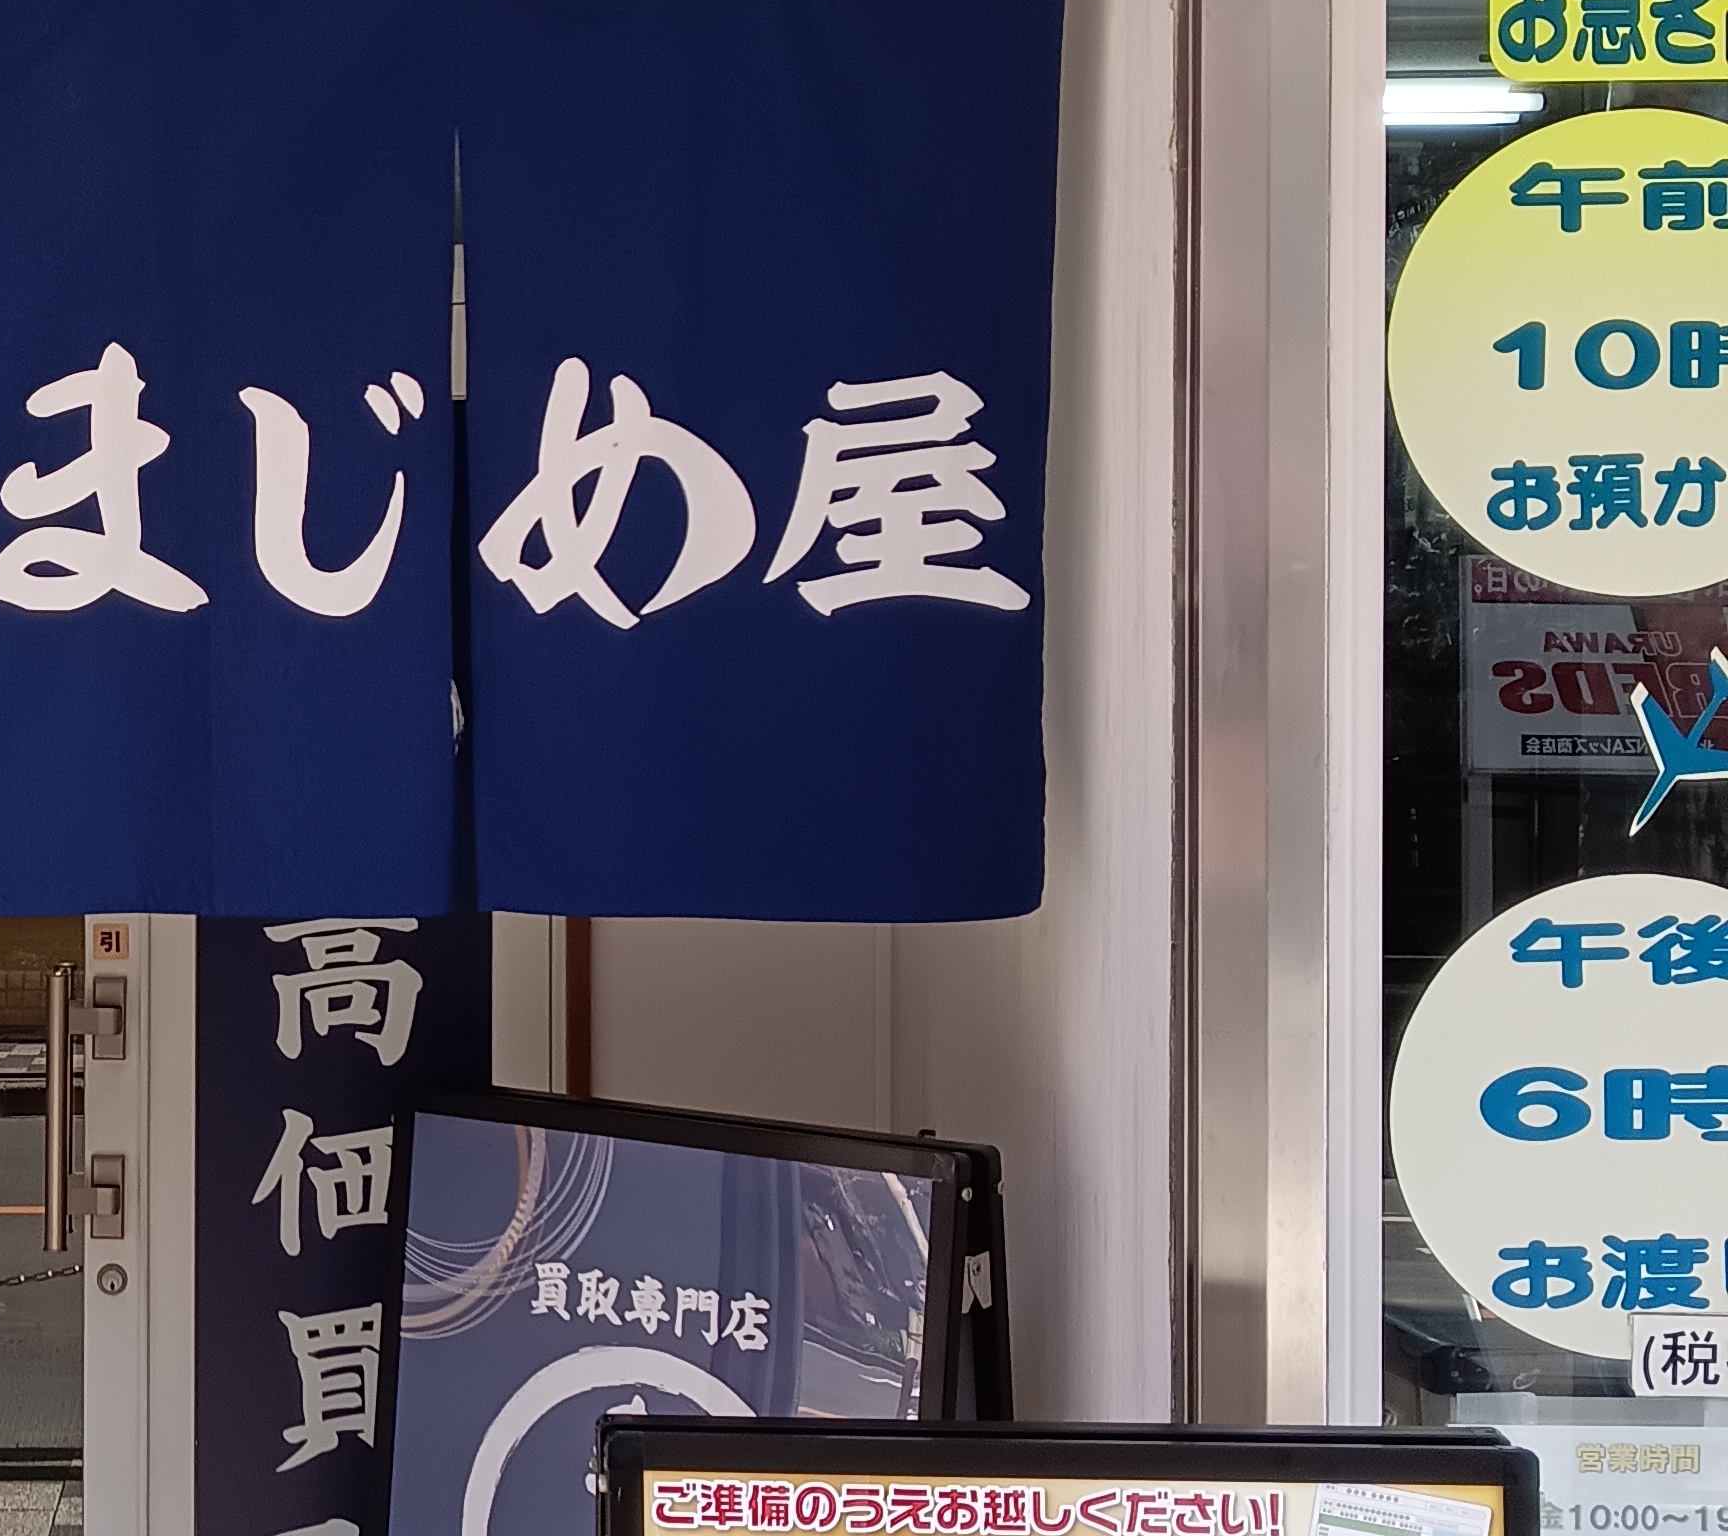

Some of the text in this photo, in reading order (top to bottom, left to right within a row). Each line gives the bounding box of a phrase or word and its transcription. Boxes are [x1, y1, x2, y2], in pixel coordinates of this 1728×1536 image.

[1509, 159, 1728, 233] 午前
[1486, 452, 1726, 531] お預か
[98, 930, 122, 954] 引
[1509, 914, 1728, 989] 午後
[1479, 1065, 1728, 1142] 6時
[529, 1262, 771, 1353] 買取専門店
[1491, 1233, 1728, 1310] お渡
[1642, 1330, 1728, 1390] (税
[1576, 1443, 1701, 1474] 営業時間
[654, 1484, 1284, 1536] ご準備のうえお越しください!
